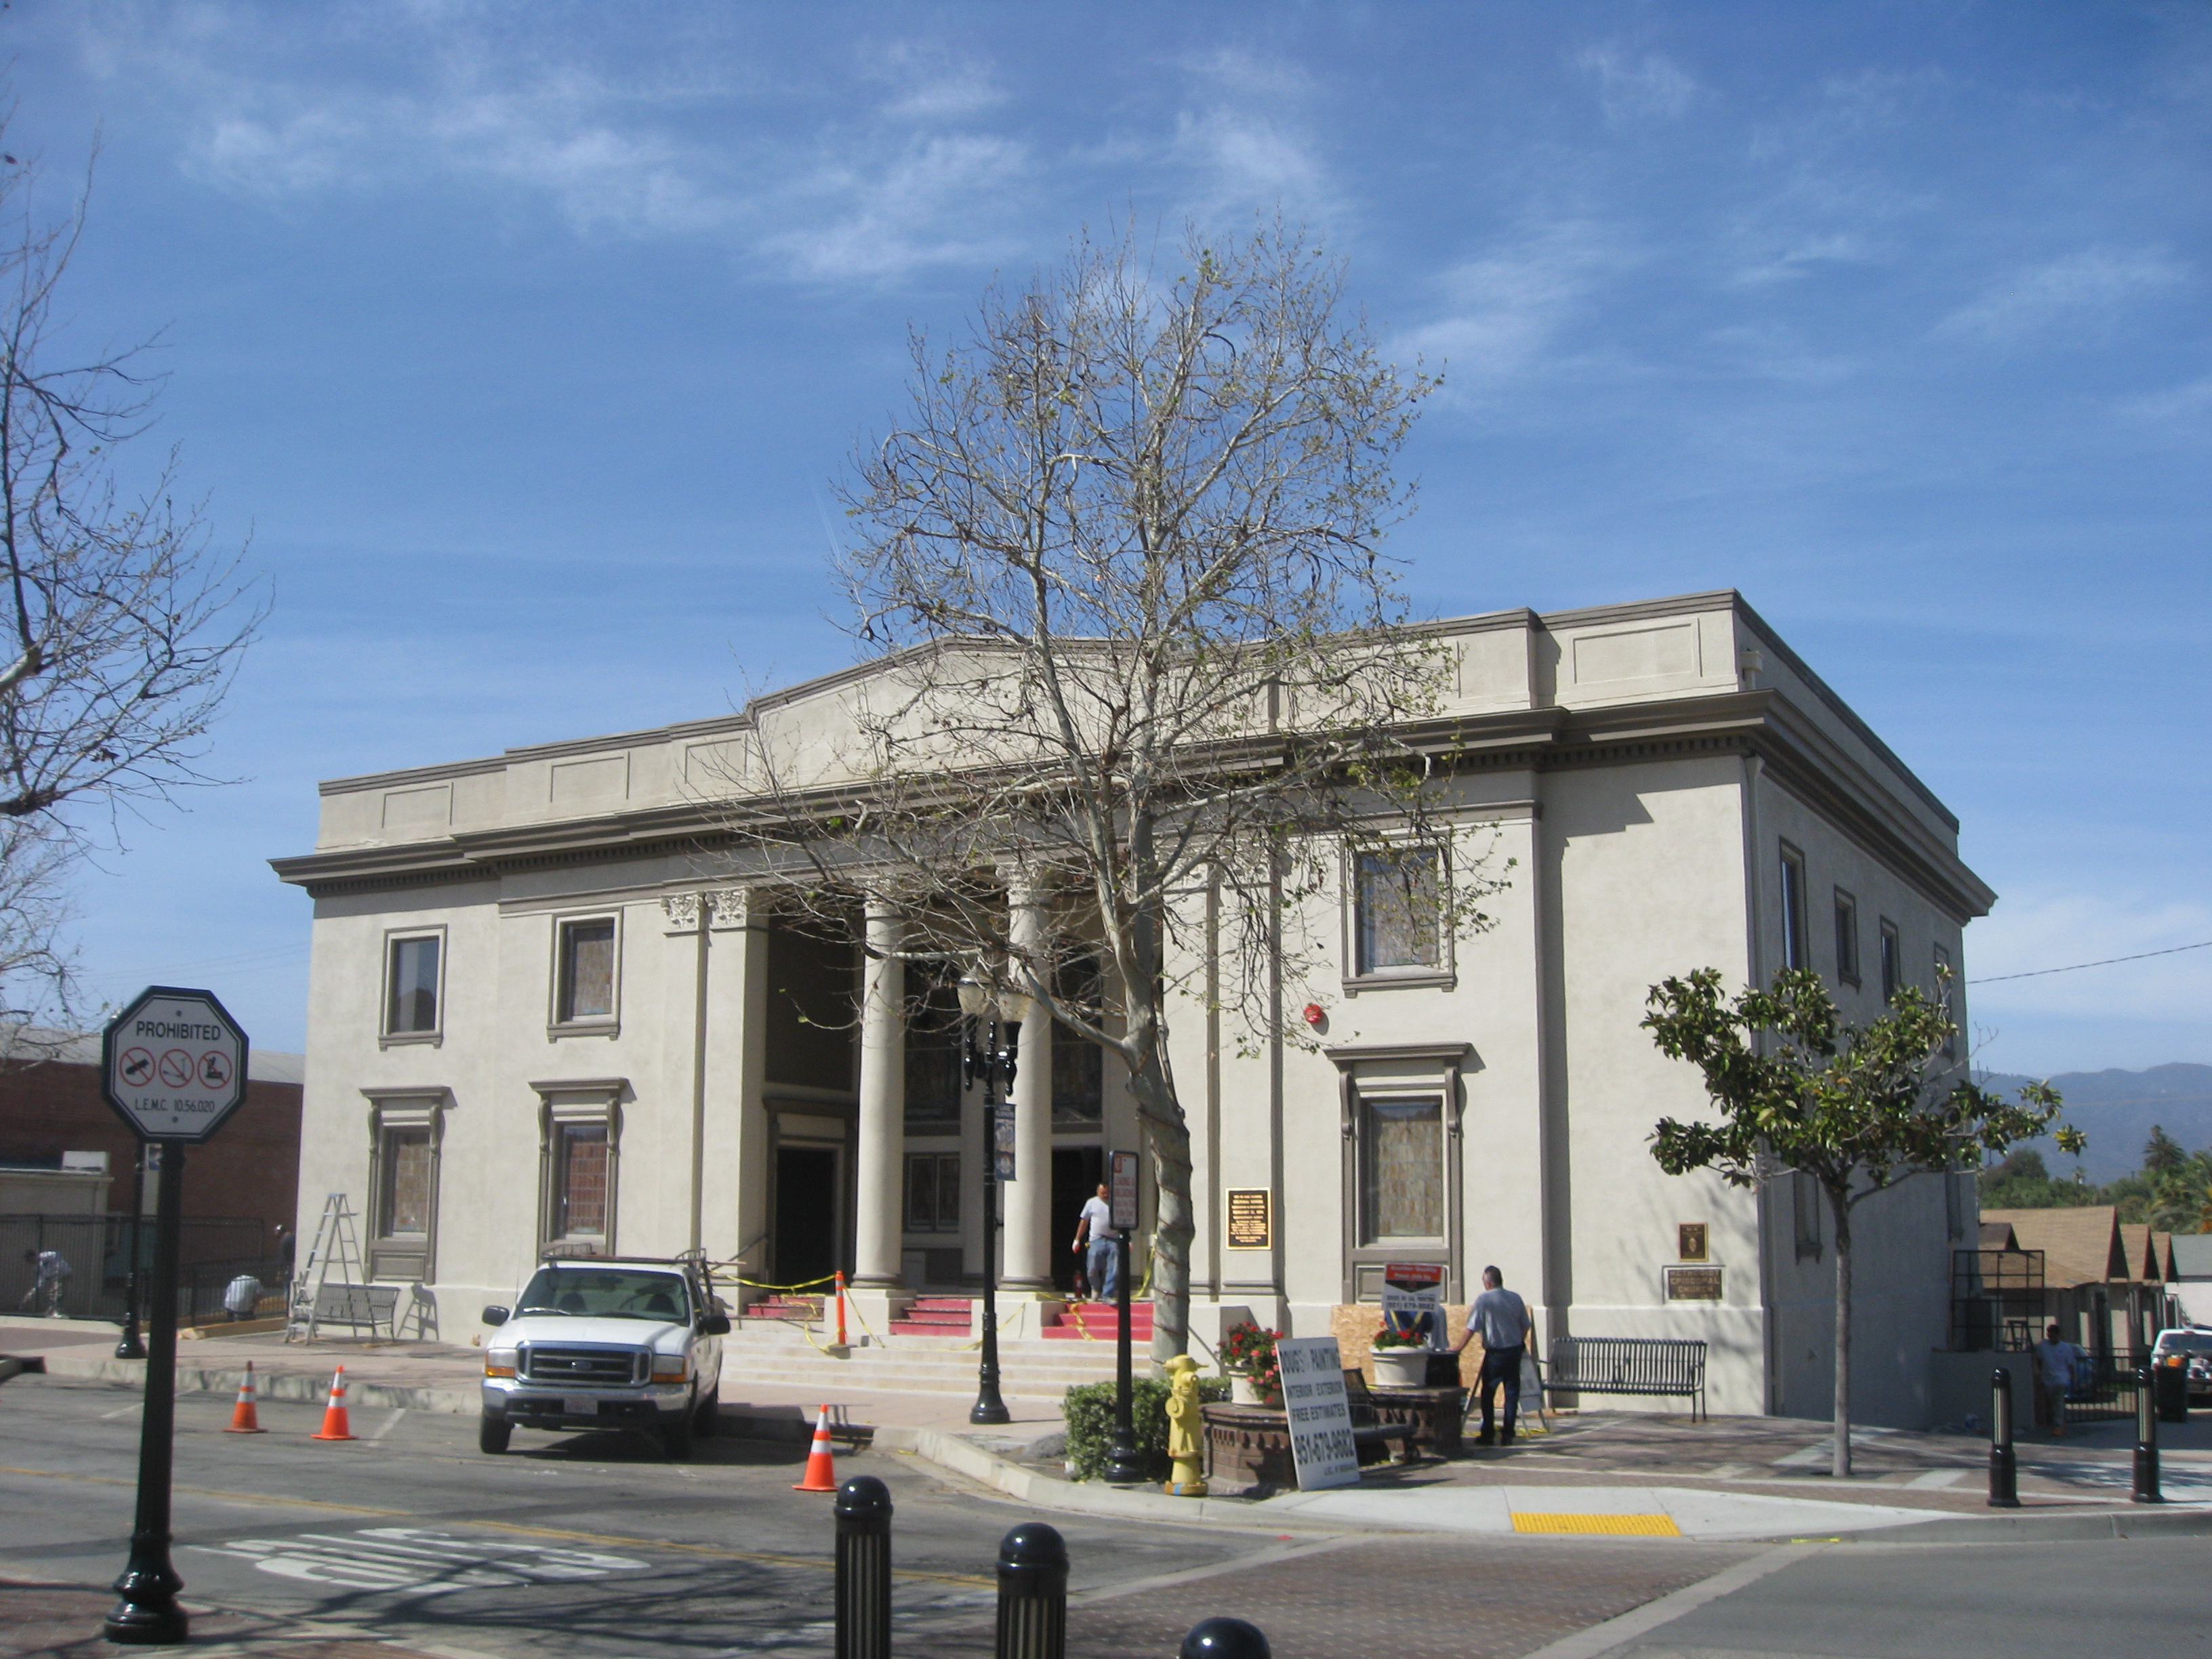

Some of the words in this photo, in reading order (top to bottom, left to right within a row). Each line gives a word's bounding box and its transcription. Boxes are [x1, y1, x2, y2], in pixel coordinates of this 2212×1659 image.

[136, 1021, 221, 1040] PROHIBITED
[174, 1101, 216, 1112] 10.56.020
[1316, 1380, 1343, 1396] EXTERIOR
[1292, 1407, 1309, 1422] FREE
[1310, 1403, 1345, 1420] ESTIMATES
[184, 1527, 651, 1593] STOP
